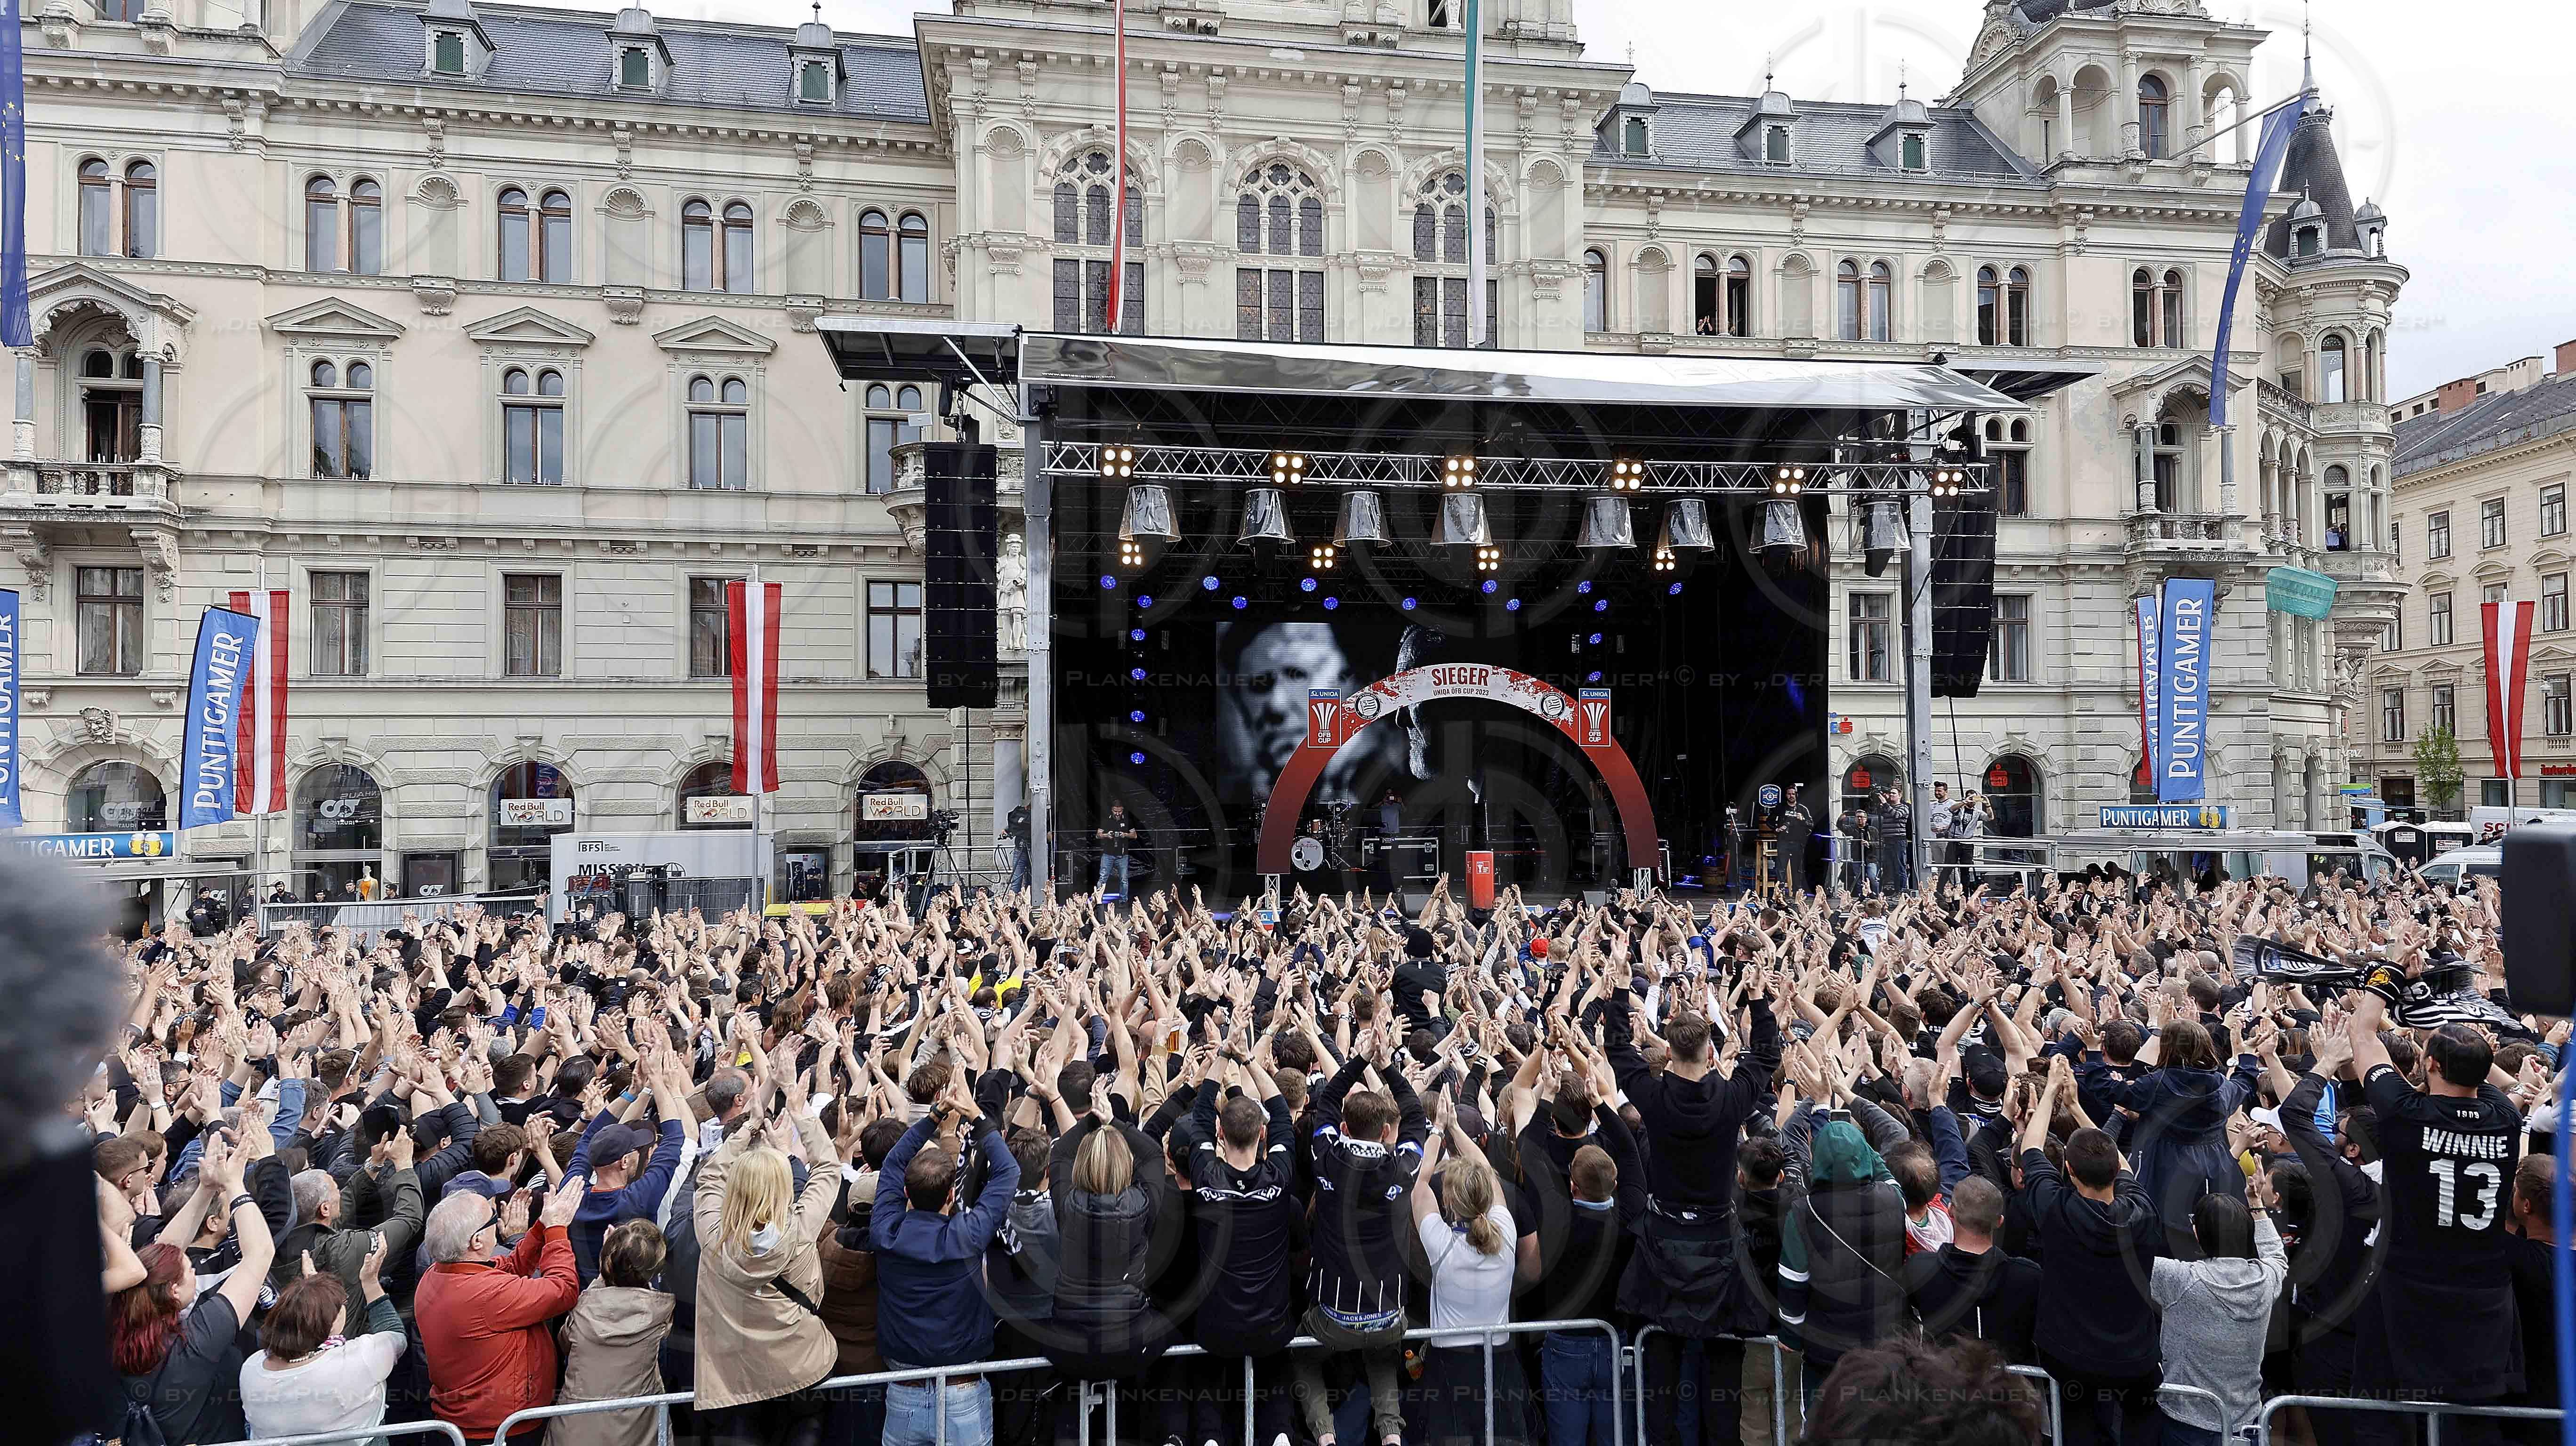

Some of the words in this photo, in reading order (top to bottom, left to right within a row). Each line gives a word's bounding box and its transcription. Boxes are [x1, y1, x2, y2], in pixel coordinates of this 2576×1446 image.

[1432, 667, 1489, 686] SIEGER
[2168, 598, 2203, 779] PUNTIGAMER
[193, 632, 243, 809] PUNTIGAMER
[527, 802, 544, 810] Bull
[2102, 808, 2190, 827] PUNTIGAMER
[581, 844, 600, 852] BFS
[2422, 1126, 2509, 1159] WINNIE
[2429, 1158, 2502, 1231] 13
